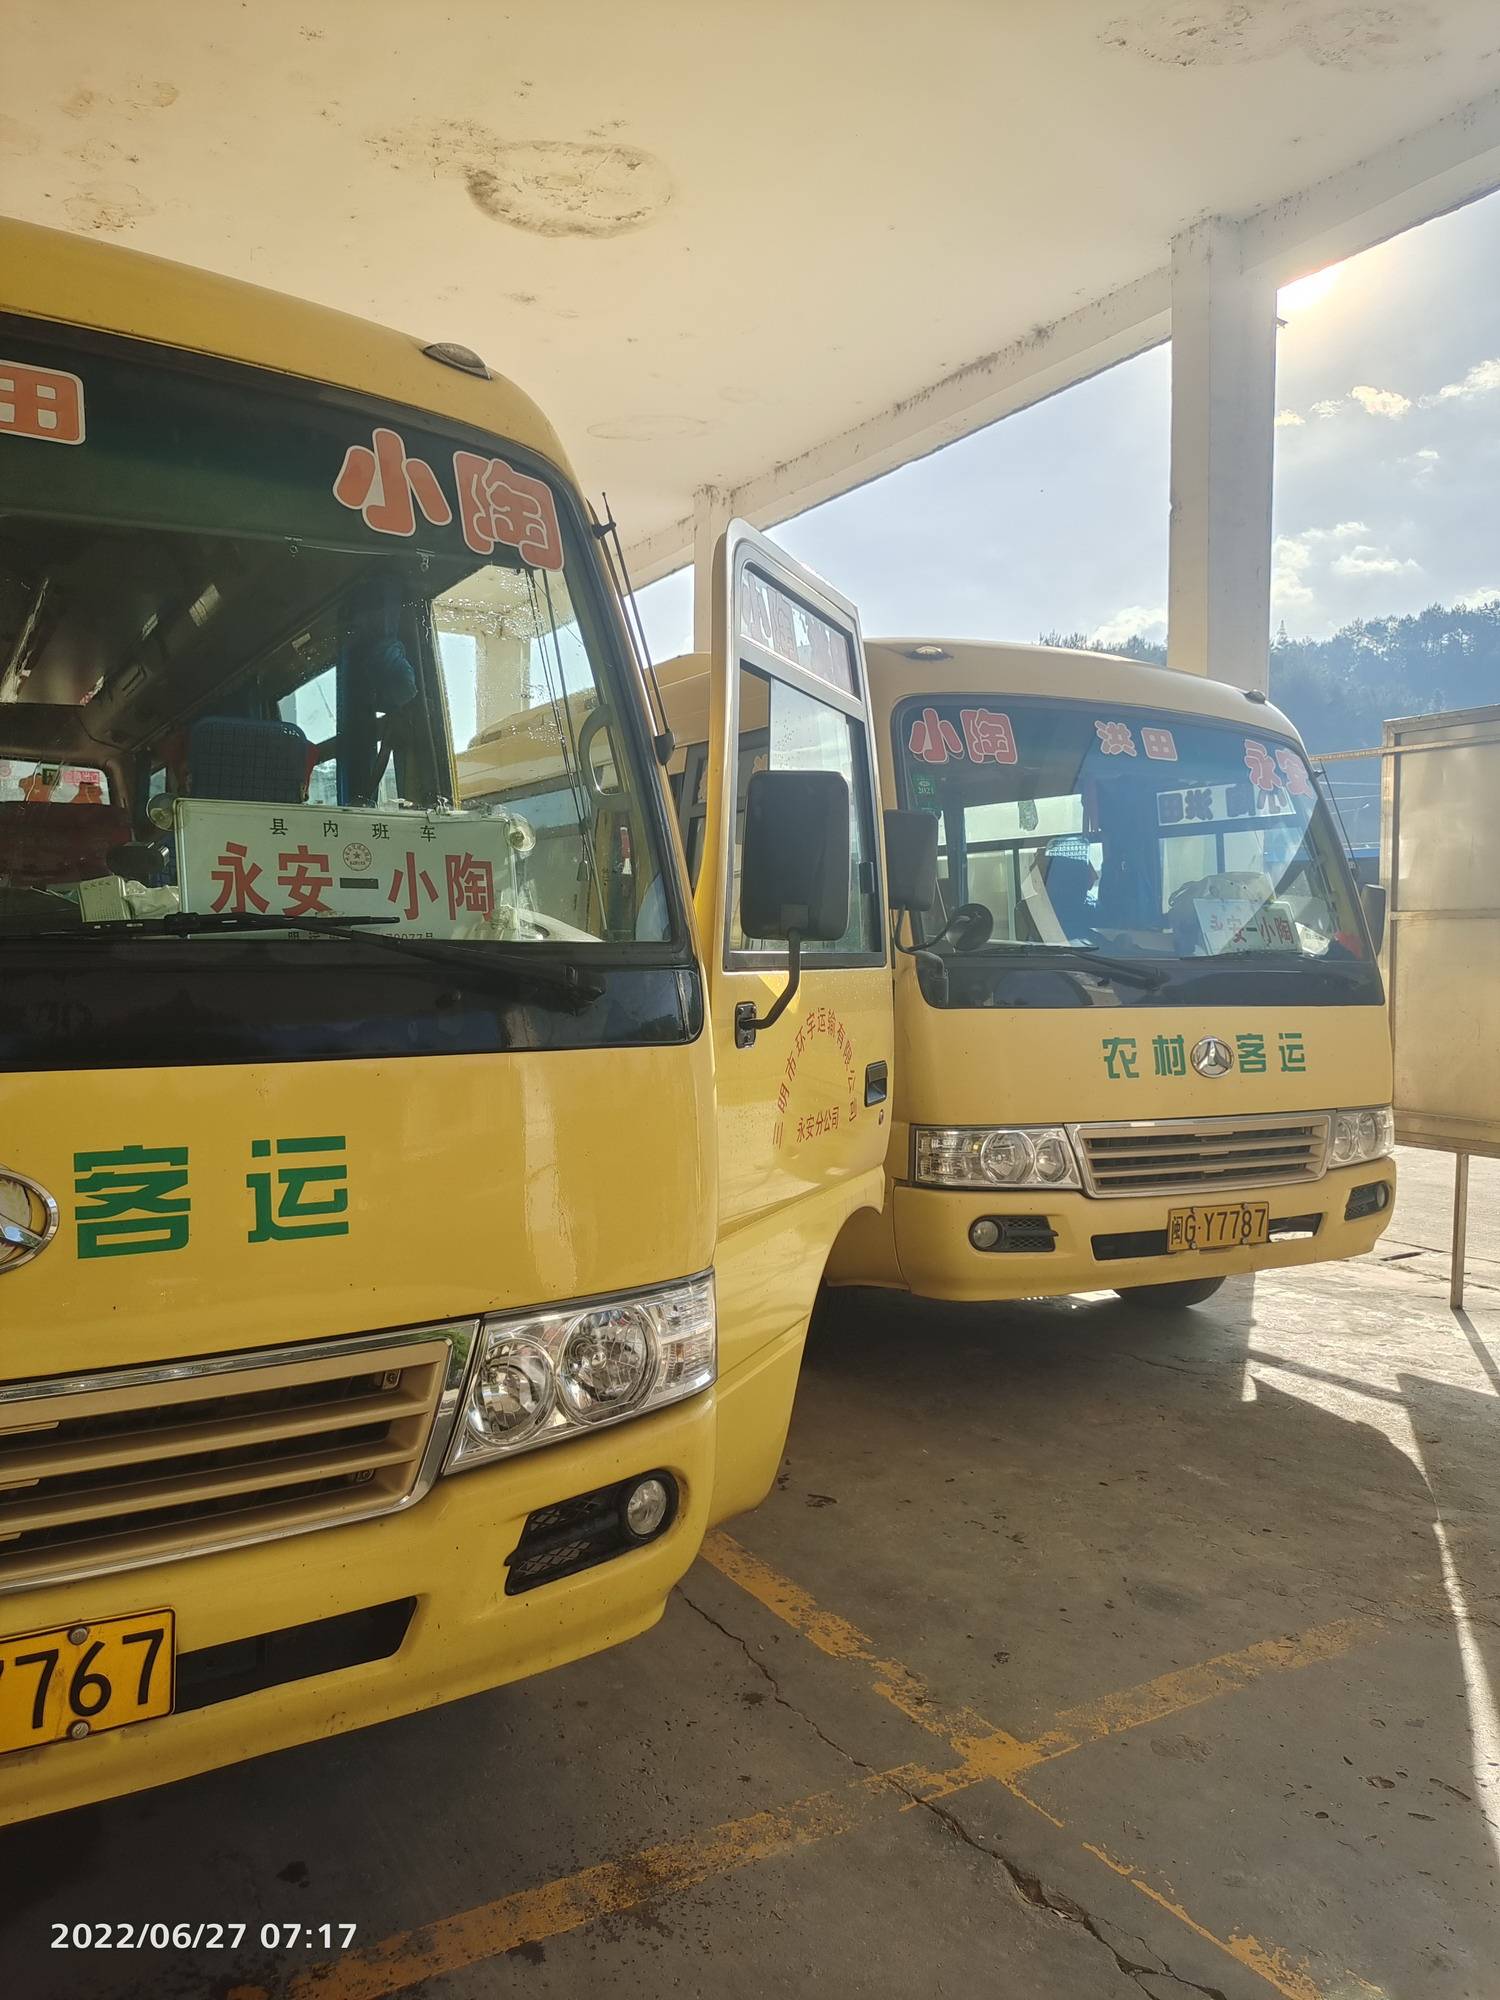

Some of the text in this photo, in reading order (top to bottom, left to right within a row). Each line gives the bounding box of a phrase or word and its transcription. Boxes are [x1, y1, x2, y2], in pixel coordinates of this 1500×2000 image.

[333, 428, 564, 572] 小陶
[908, 707, 1314, 800] 小陶 洪田 永安
[269, 817, 437, 843] 县内班车
[1102, 1032, 1306, 1079] 农村 客运
[796, 1105, 841, 1143] 永安分公司
[74, 1135, 349, 1259] 客运
[0, 1628, 164, 1729] 767
